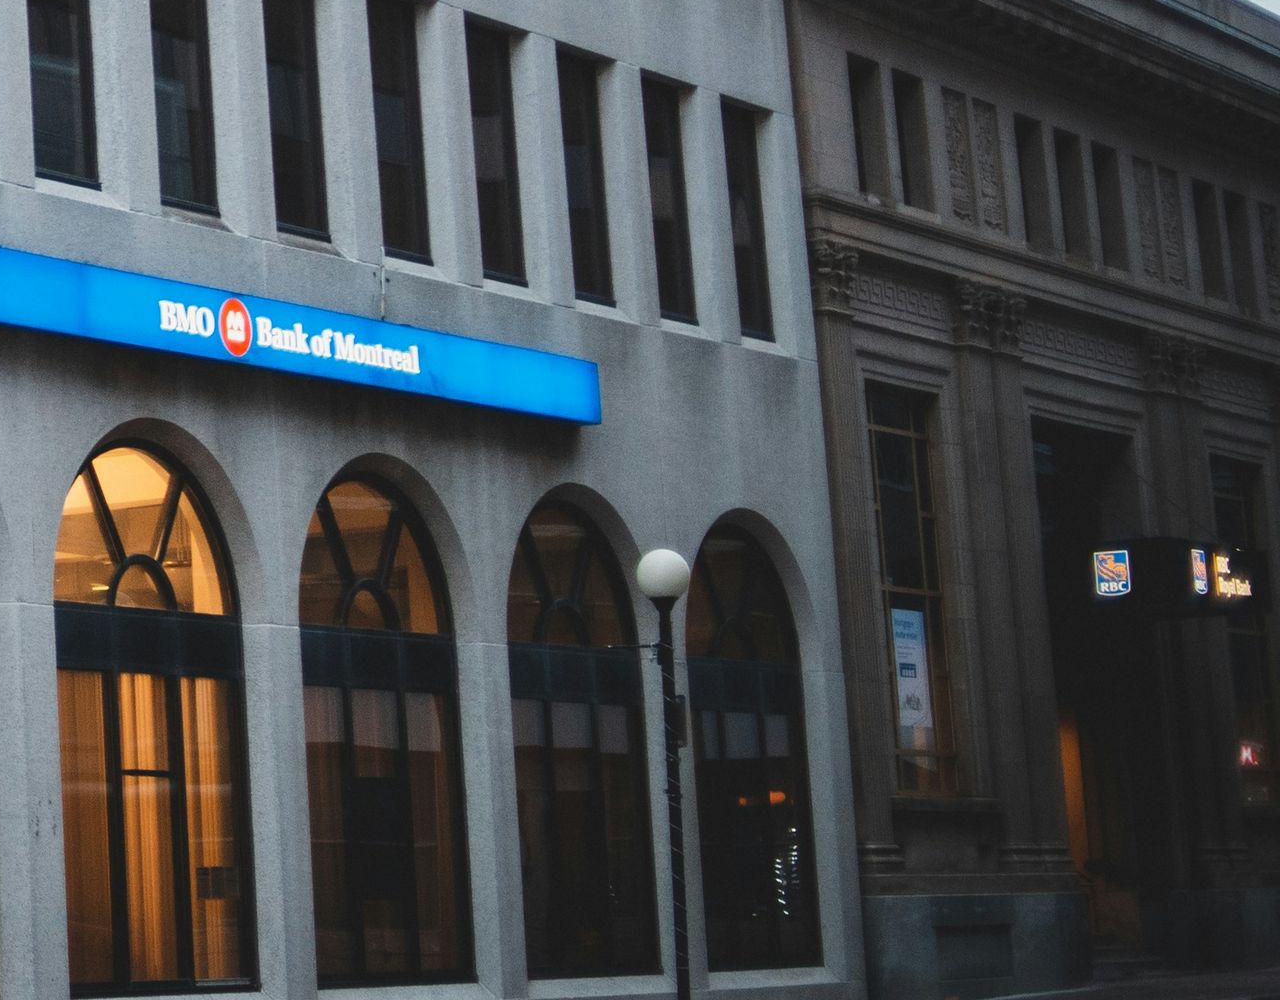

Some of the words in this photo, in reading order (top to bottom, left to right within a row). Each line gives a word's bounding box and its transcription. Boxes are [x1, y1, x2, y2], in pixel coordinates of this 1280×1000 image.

[158, 300, 215, 337] BMO
[255, 317, 311, 355] Bank
[311, 328, 334, 359] of
[333, 331, 421, 375] Montreal
[1100, 581, 1127, 593] RBC
